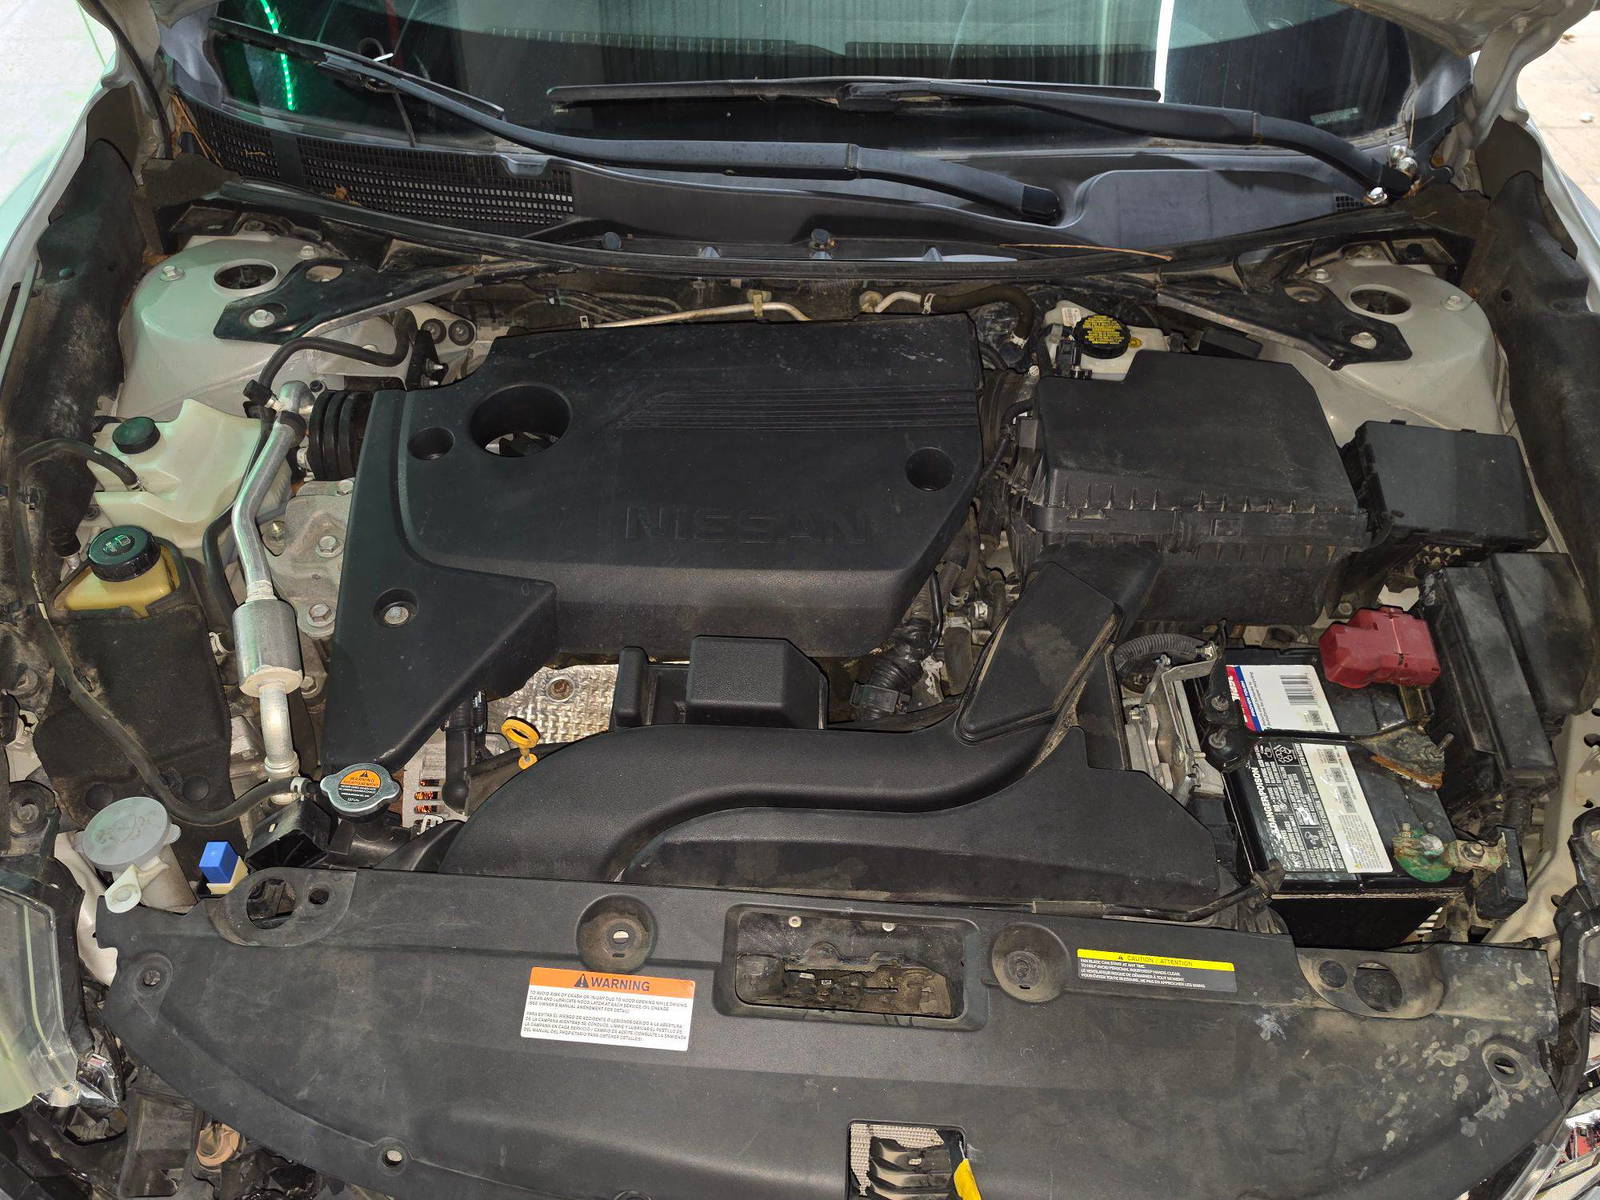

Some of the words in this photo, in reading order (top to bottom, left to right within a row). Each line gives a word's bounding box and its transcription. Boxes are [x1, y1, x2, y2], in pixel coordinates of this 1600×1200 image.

[624, 504, 867, 545] NISSAN
[1159, 958, 1192, 966] ATTENTION
[591, 976, 650, 992] WARNING
